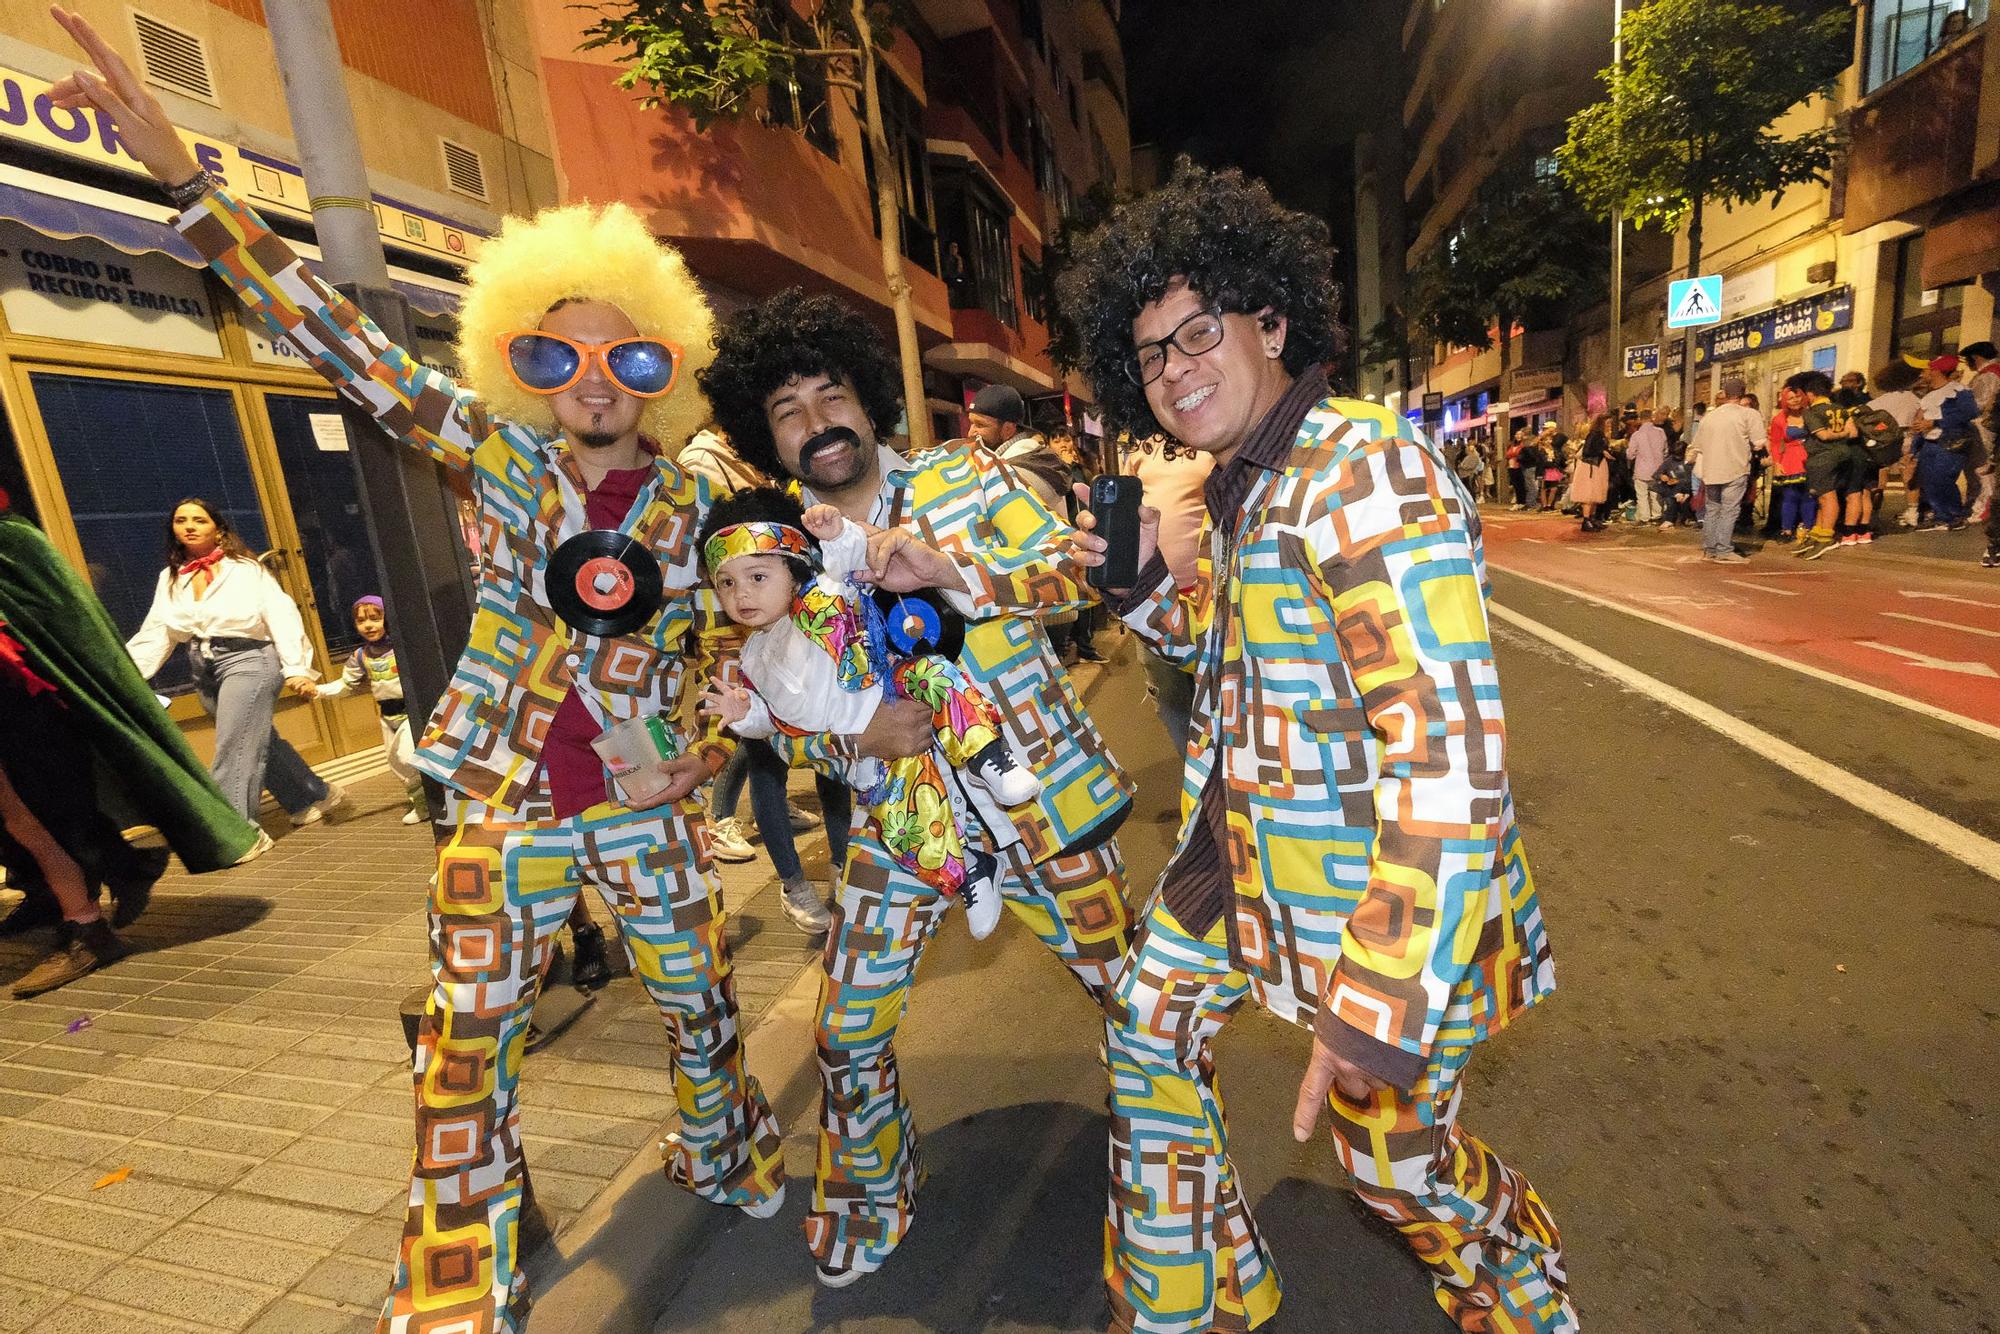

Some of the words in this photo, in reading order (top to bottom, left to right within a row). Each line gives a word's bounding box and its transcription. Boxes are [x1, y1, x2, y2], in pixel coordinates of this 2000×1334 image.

[0, 78, 229, 188] JORE
[21, 249, 101, 280] COBRO
[105, 264, 134, 286] DE
[27, 271, 124, 304] RECIBOS
[1774, 302, 1813, 325] EURO
[1774, 317, 1813, 341] BOMBA
[1628, 347, 1658, 358] EURO
[1713, 337, 1745, 356] BOMBA
[1665, 353, 1683, 369] BOM
[1626, 368, 1659, 378] BOMBA
